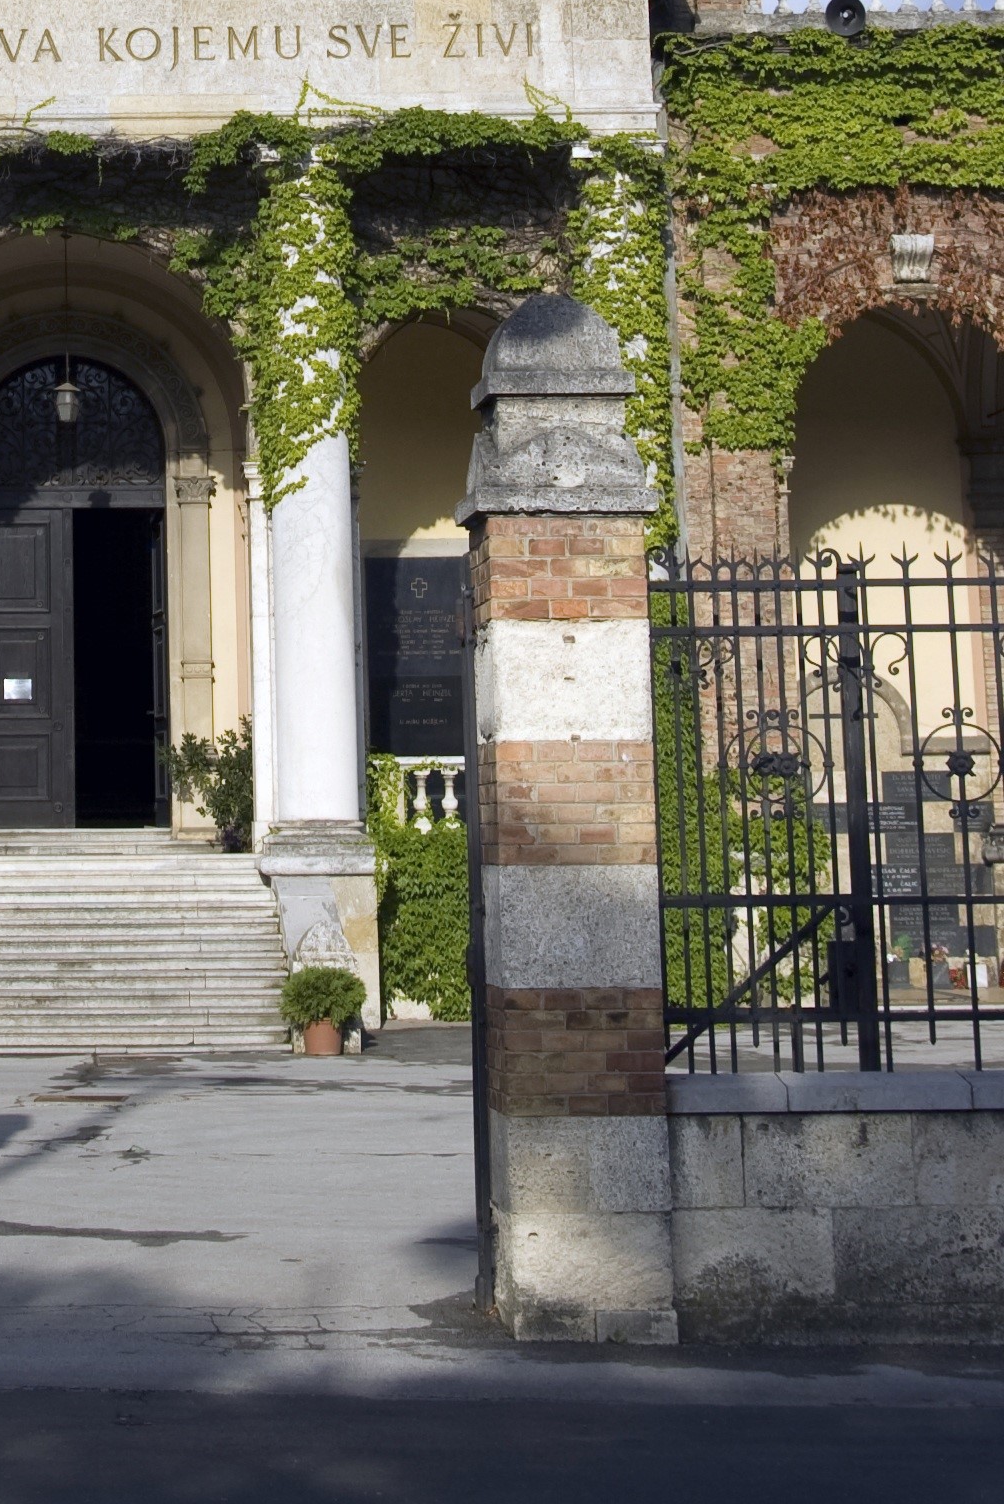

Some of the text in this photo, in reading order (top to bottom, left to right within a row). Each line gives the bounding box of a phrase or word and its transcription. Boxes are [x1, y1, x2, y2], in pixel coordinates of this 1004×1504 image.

[98, 25, 300, 71] KOJEMU
[327, 24, 411, 59] SVE
[442, 13, 533, 57] ŽIVI
